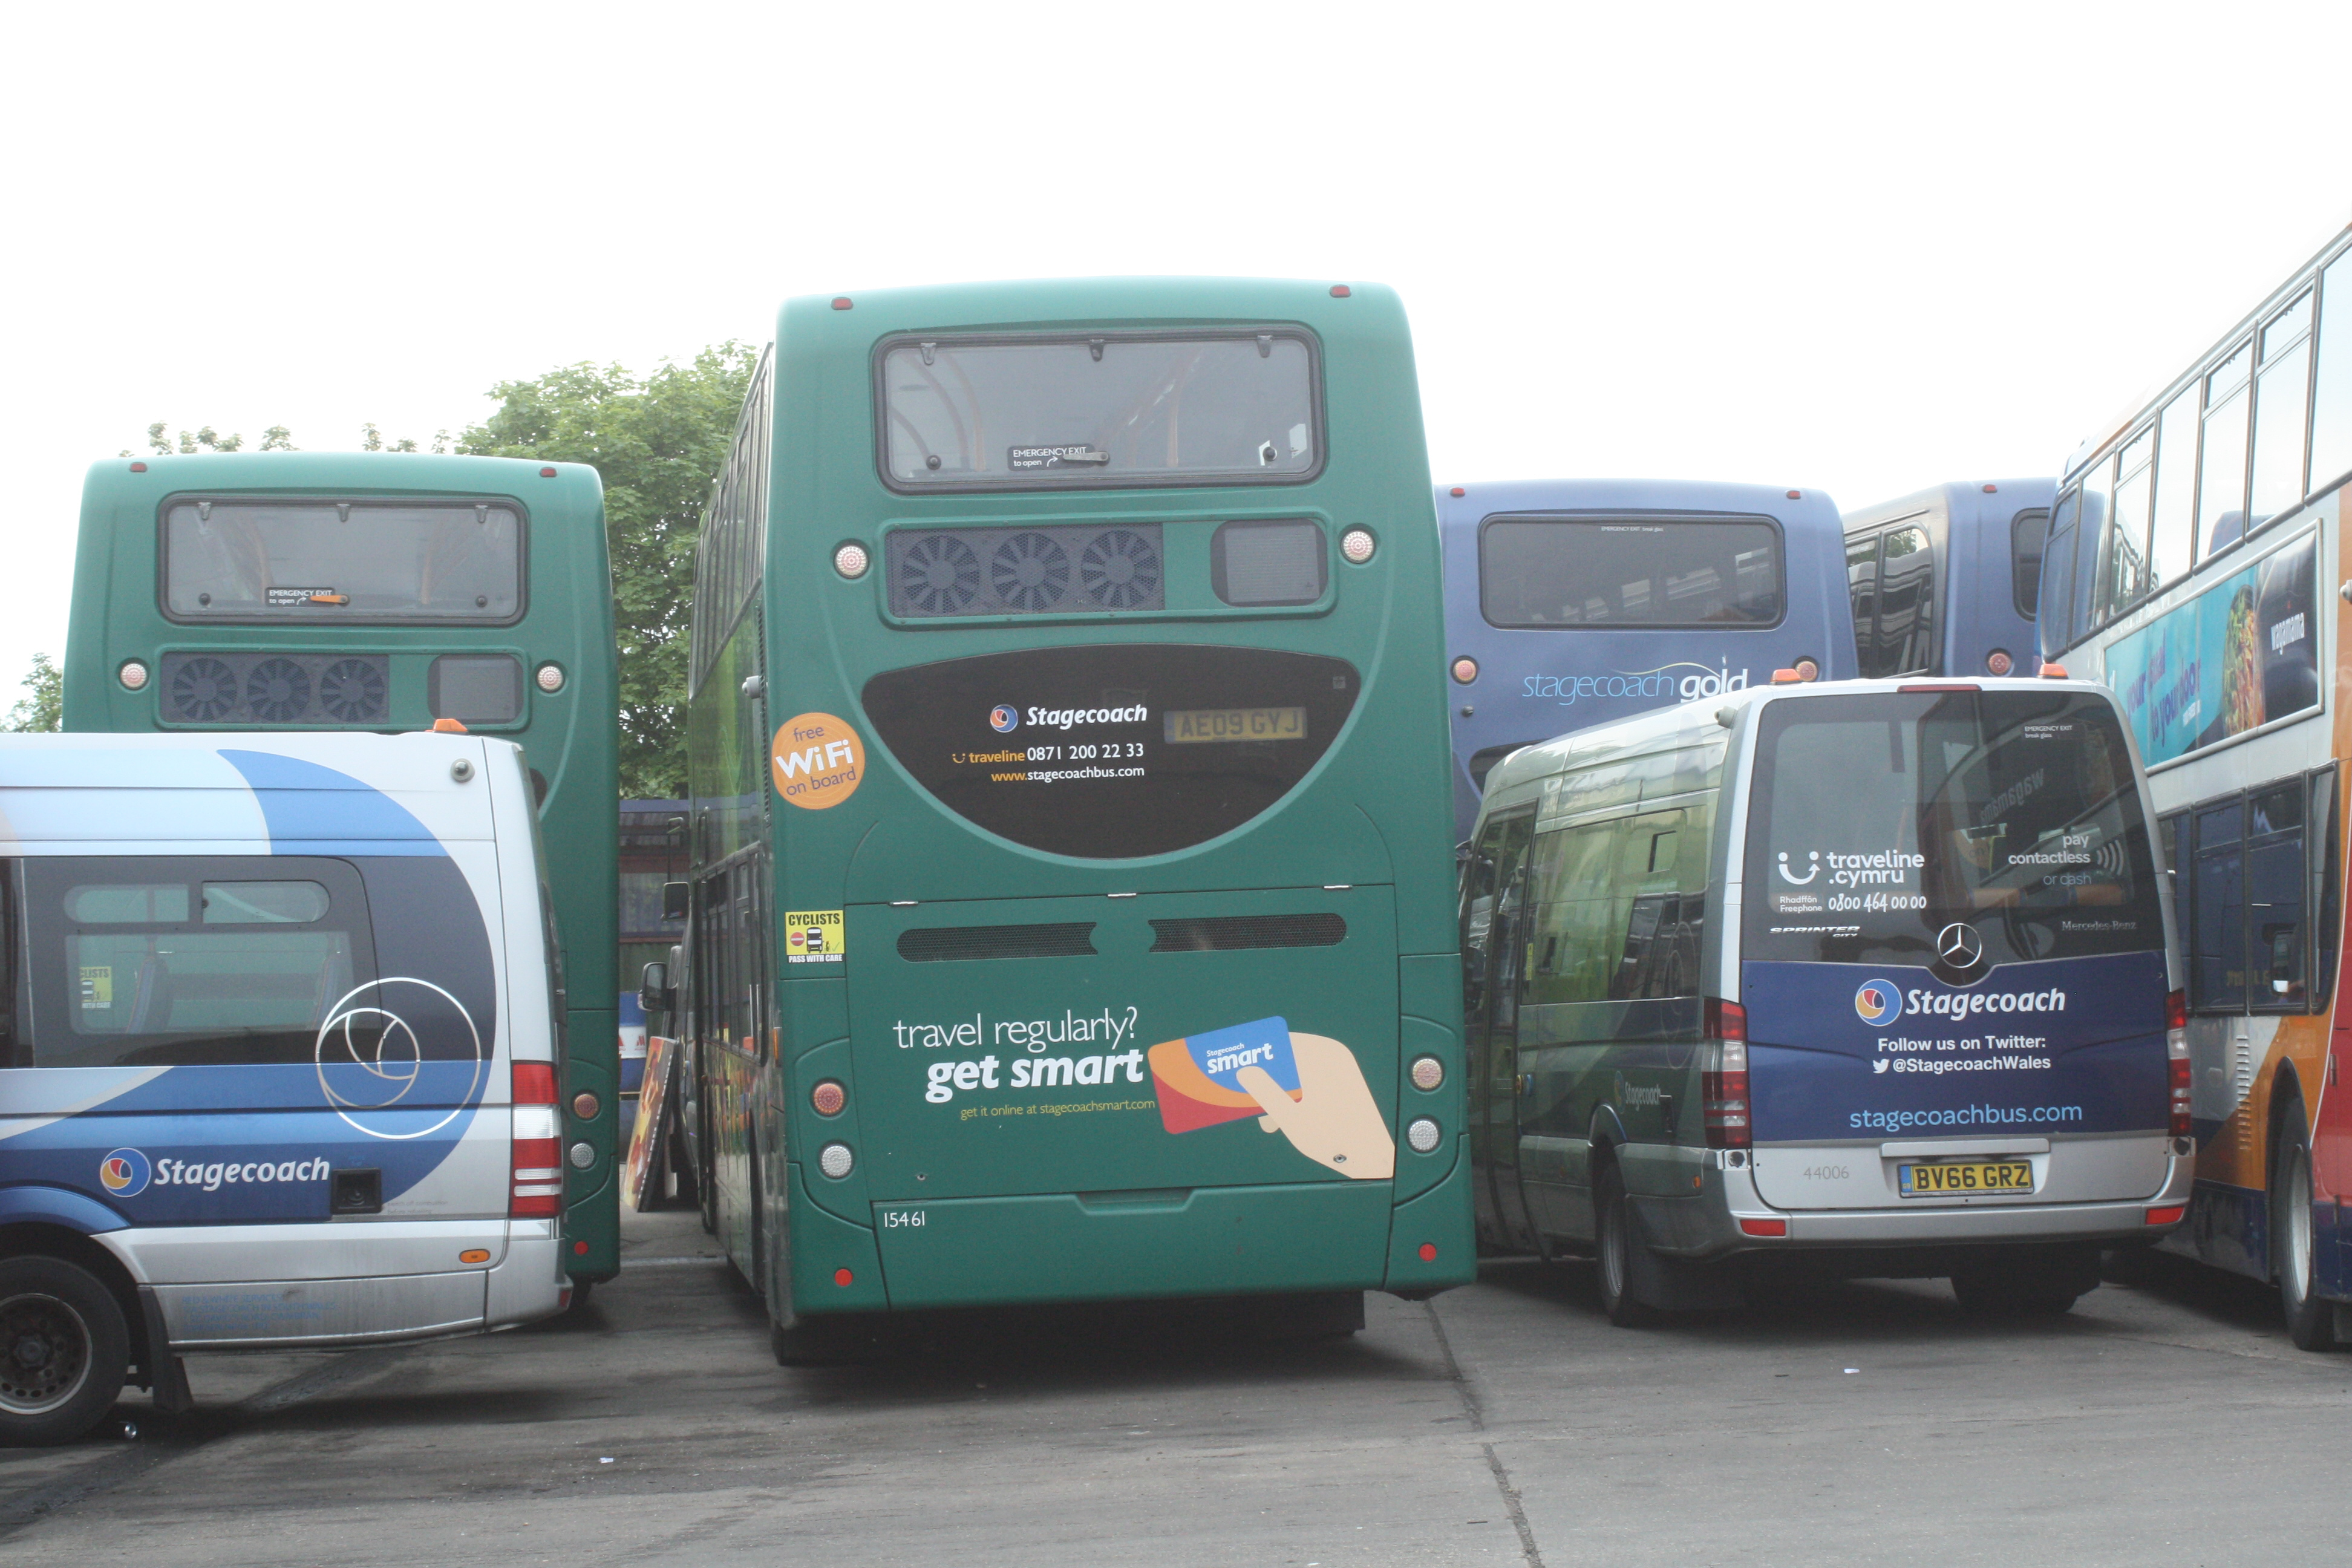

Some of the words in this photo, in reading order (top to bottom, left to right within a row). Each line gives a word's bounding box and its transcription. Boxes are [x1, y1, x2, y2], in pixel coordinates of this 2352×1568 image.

[1013, 447, 1067, 457] EMERGENCY
[2270, 612, 2305, 655] wagamama
[1521, 670, 1674, 706] stagecoach
[1679, 668, 1749, 704] gold
[1026, 704, 1148, 730] Stagecoach
[1180, 712, 1244, 737] AE09
[1250, 710, 1299, 734] GYJ
[793, 727, 825, 742] free
[776, 739, 854, 779] WiFi
[969, 750, 1025, 763] traveline
[1027, 746, 1062, 761] 0871
[1069, 745, 1097, 759] 200
[1102, 744, 1121, 758] 22
[1126, 743, 1144, 757] 33
[786, 783, 806, 795] on
[810, 766, 857, 790] board
[991, 766, 1145, 783] www.stagecoachbus.com
[2062, 835, 2089, 848] pay
[1826, 849, 1925, 869] traveline
[2008, 851, 2091, 864] contactless
[1828, 869, 1904, 889] .cymru
[2043, 875, 2056, 885] or
[2060, 872, 2092, 885] cash
[1780, 895, 1817, 904] Rhadffôn
[1780, 904, 1823, 913] Freephone
[1828, 893, 1861, 912] 0800
[1863, 892, 1888, 913] 464
[1891, 897, 1907, 909] 00
[1910, 896, 1927, 909] 00
[788, 913, 840, 926] CYCLISTS
[2061, 920, 2137, 931] Mercedes-Benz
[1905, 987, 2066, 1021] Stagecoach
[892, 1012, 983, 1048] travel
[994, 1005, 1138, 1053] regularly?
[1206, 1042, 1244, 1057] Stagecoach
[1878, 1037, 1932, 1052] Follow
[1936, 1038, 1956, 1051] us
[1960, 1037, 1981, 1050] on
[1984, 1034, 2046, 1049] Twitter:
[1207, 1043, 1274, 1074] smart
[1893, 1055, 2051, 1074] @StagecoachWales
[924, 1055, 999, 1103] get
[1010, 1049, 1143, 1088] smart
[1625, 1082, 1661, 1112] Stagecoach
[961, 1106, 978, 1121] get
[980, 1105, 988, 1117] it
[991, 1103, 1024, 1116] online
[1027, 1104, 1037, 1115] at
[1040, 1099, 1155, 1117] stagecoachsmart.com
[1849, 1103, 2083, 1132] stagecoachbus.com
[154, 1156, 330, 1192] Stagecoach
[1803, 1165, 1850, 1180] 44006
[1915, 1166, 1977, 1190] BV66
[1983, 1165, 2029, 1187] GRZ
[884, 1210, 926, 1227] 15461
